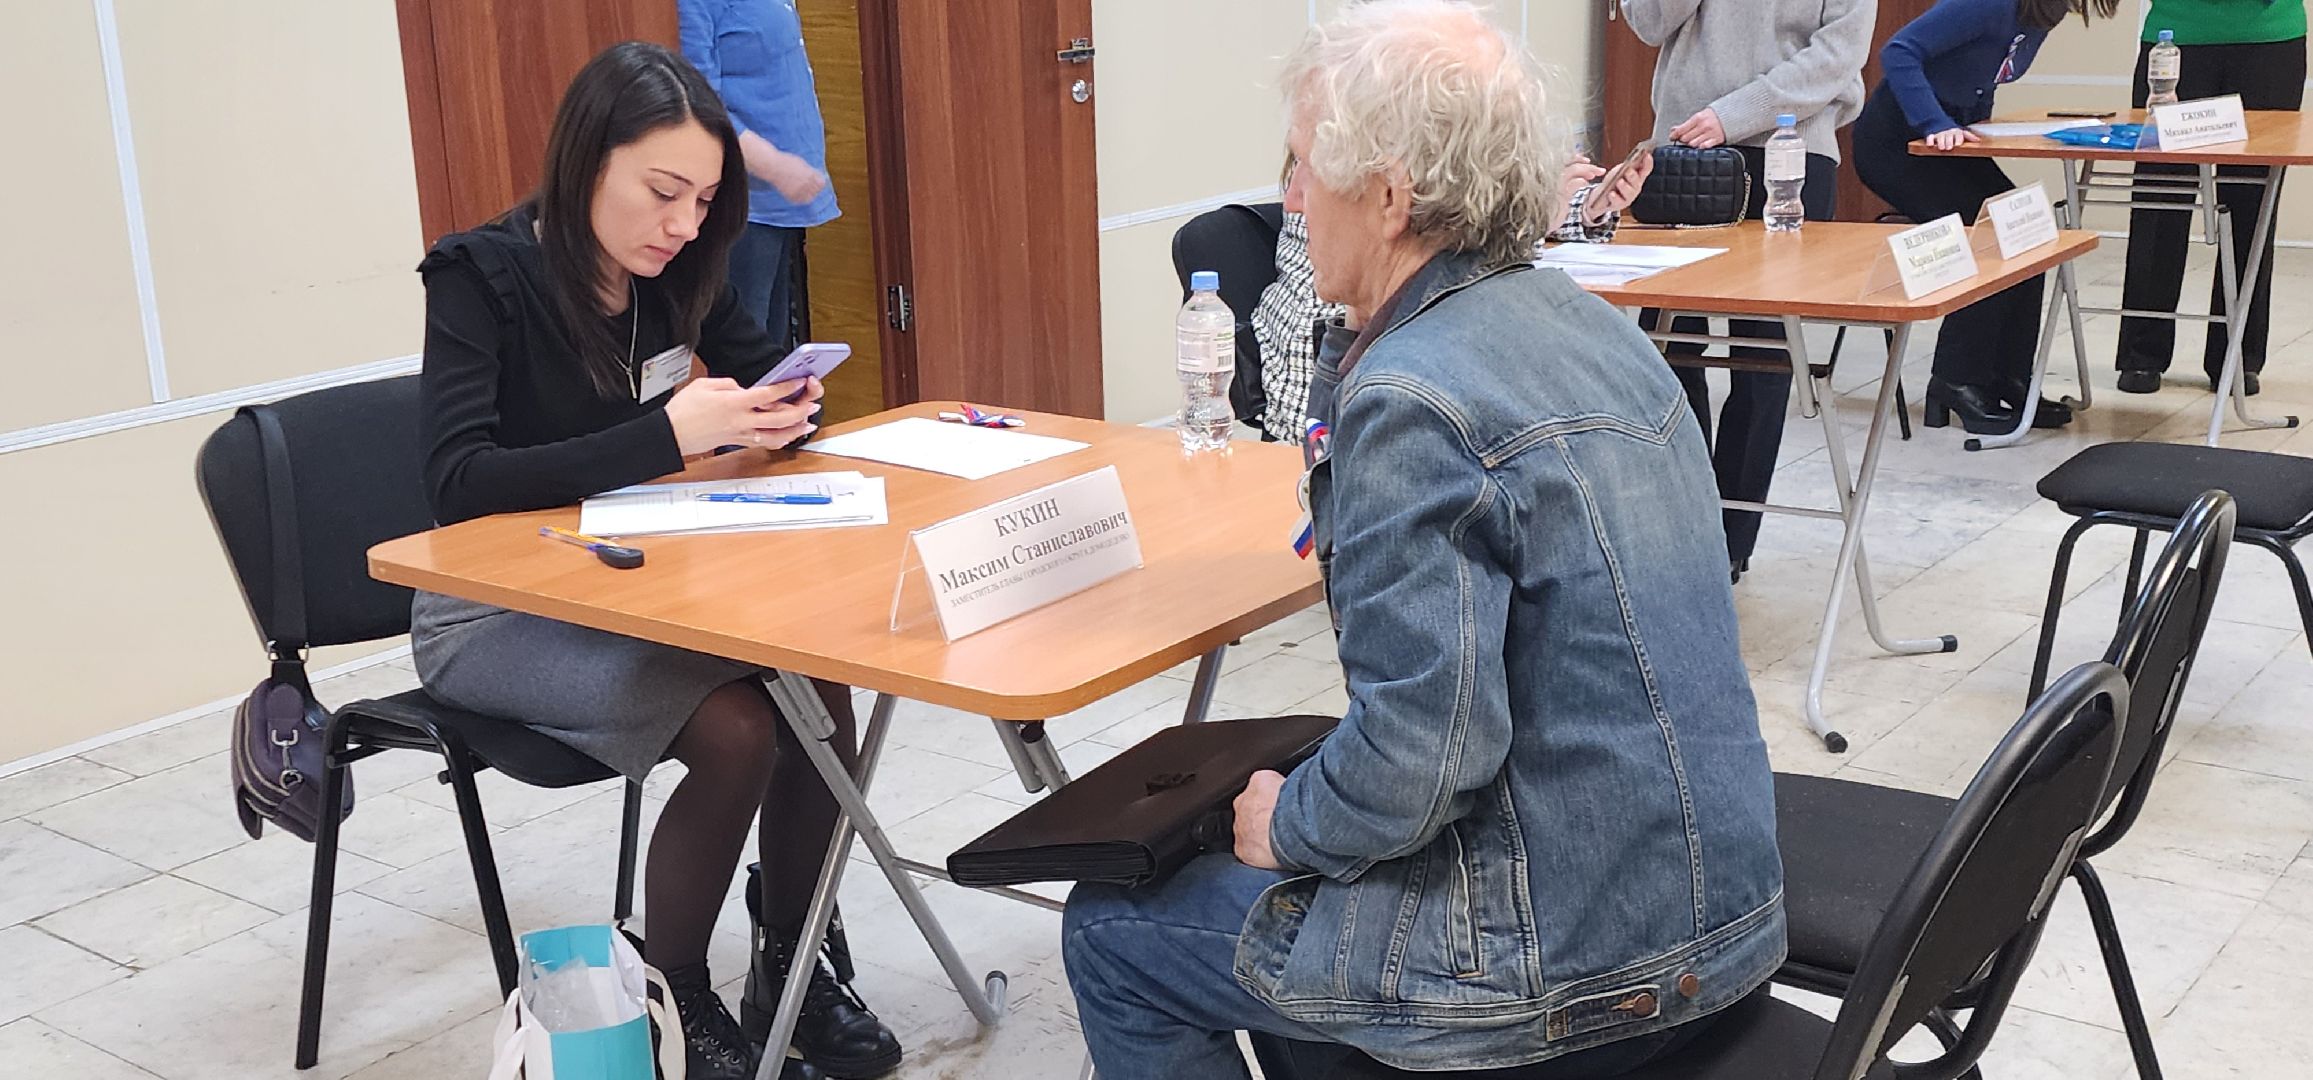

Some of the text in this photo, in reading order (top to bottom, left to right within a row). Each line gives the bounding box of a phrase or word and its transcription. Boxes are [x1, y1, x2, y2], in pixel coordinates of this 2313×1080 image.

[993, 497, 1061, 538] КУКИН
[938, 511, 1128, 593] Максим Станиславович
